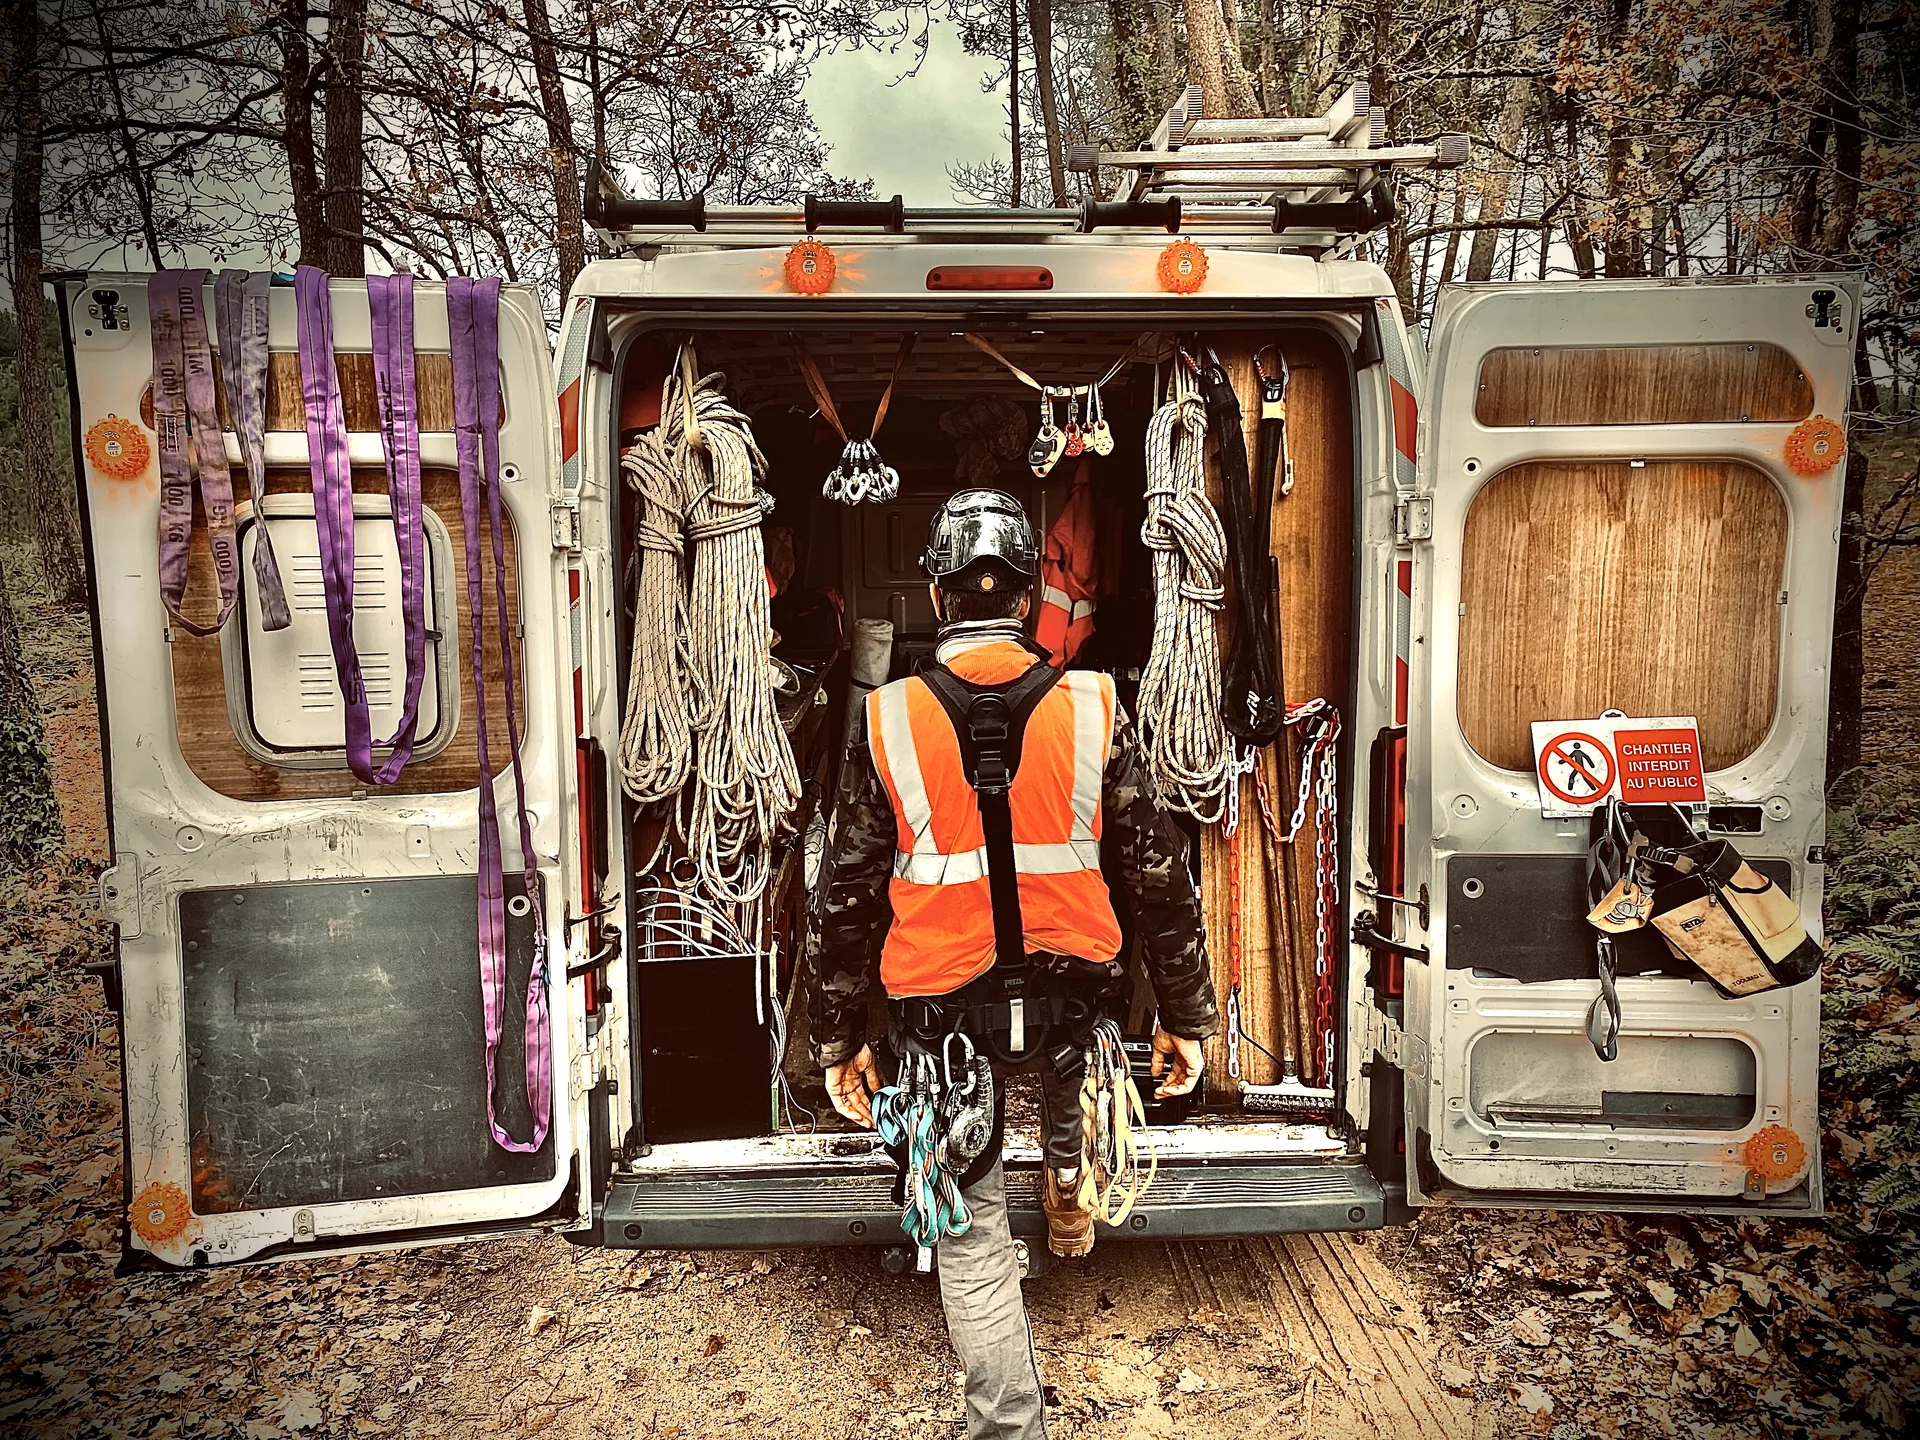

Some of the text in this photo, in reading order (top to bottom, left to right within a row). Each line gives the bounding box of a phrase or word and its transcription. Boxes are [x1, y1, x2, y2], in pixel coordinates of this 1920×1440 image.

[179, 287, 197, 324] 1000
[168, 522, 185, 544] KG
[215, 541, 233, 577] 1000
[1622, 743, 1692, 755] CHANTIER
[1628, 760, 1691, 772] INTERDIT
[1626, 776, 1698, 789] AU PUBLIC
[1680, 917, 1705, 932] PETZL
[1004, 978, 1025, 988] PETZL
